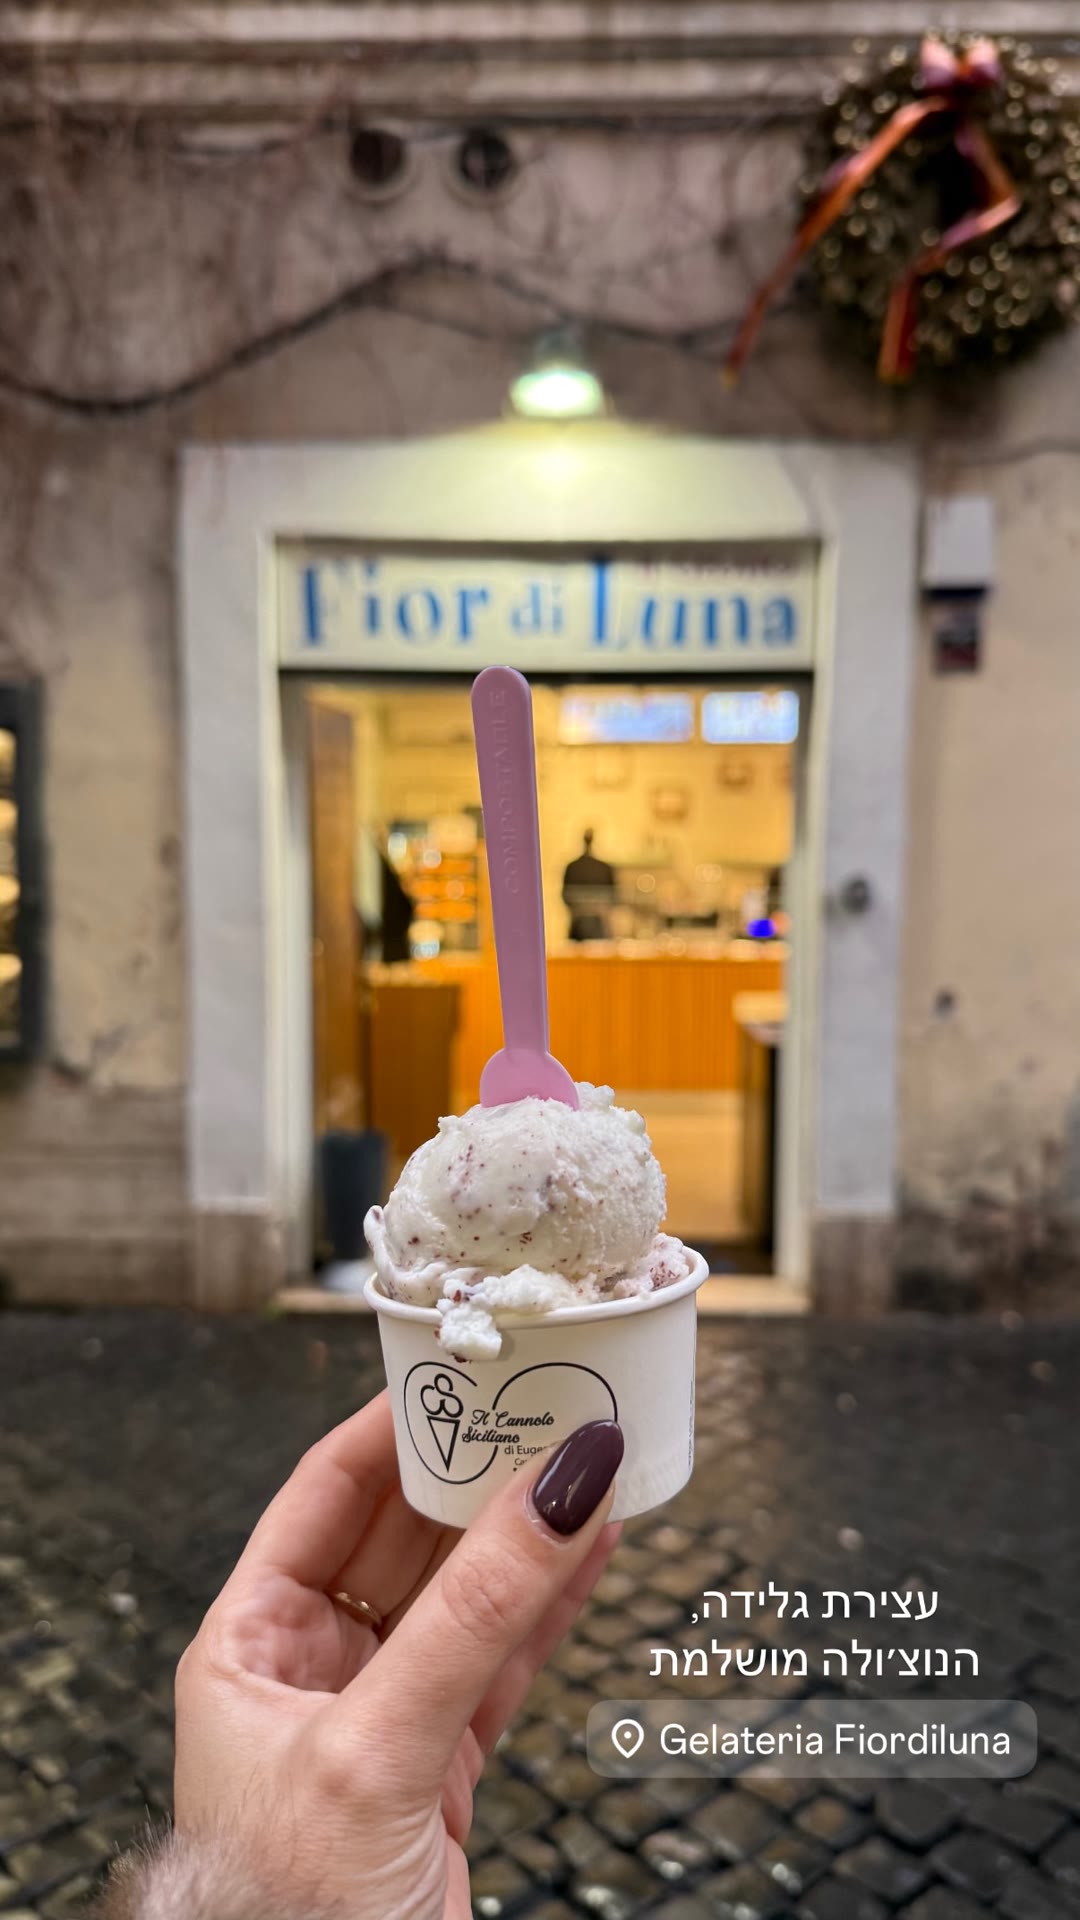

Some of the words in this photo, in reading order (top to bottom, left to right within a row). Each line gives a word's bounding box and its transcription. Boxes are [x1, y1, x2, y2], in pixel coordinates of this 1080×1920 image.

[300, 558, 490, 649] Fior
[511, 582, 564, 634] di
[584, 554, 797, 649] Luna
[495, 1410, 555, 1428] Cannolo
[461, 1426, 521, 1443] Siciliano
[504, 1445, 514, 1455] di
[517, 1445, 546, 1457] Euge
